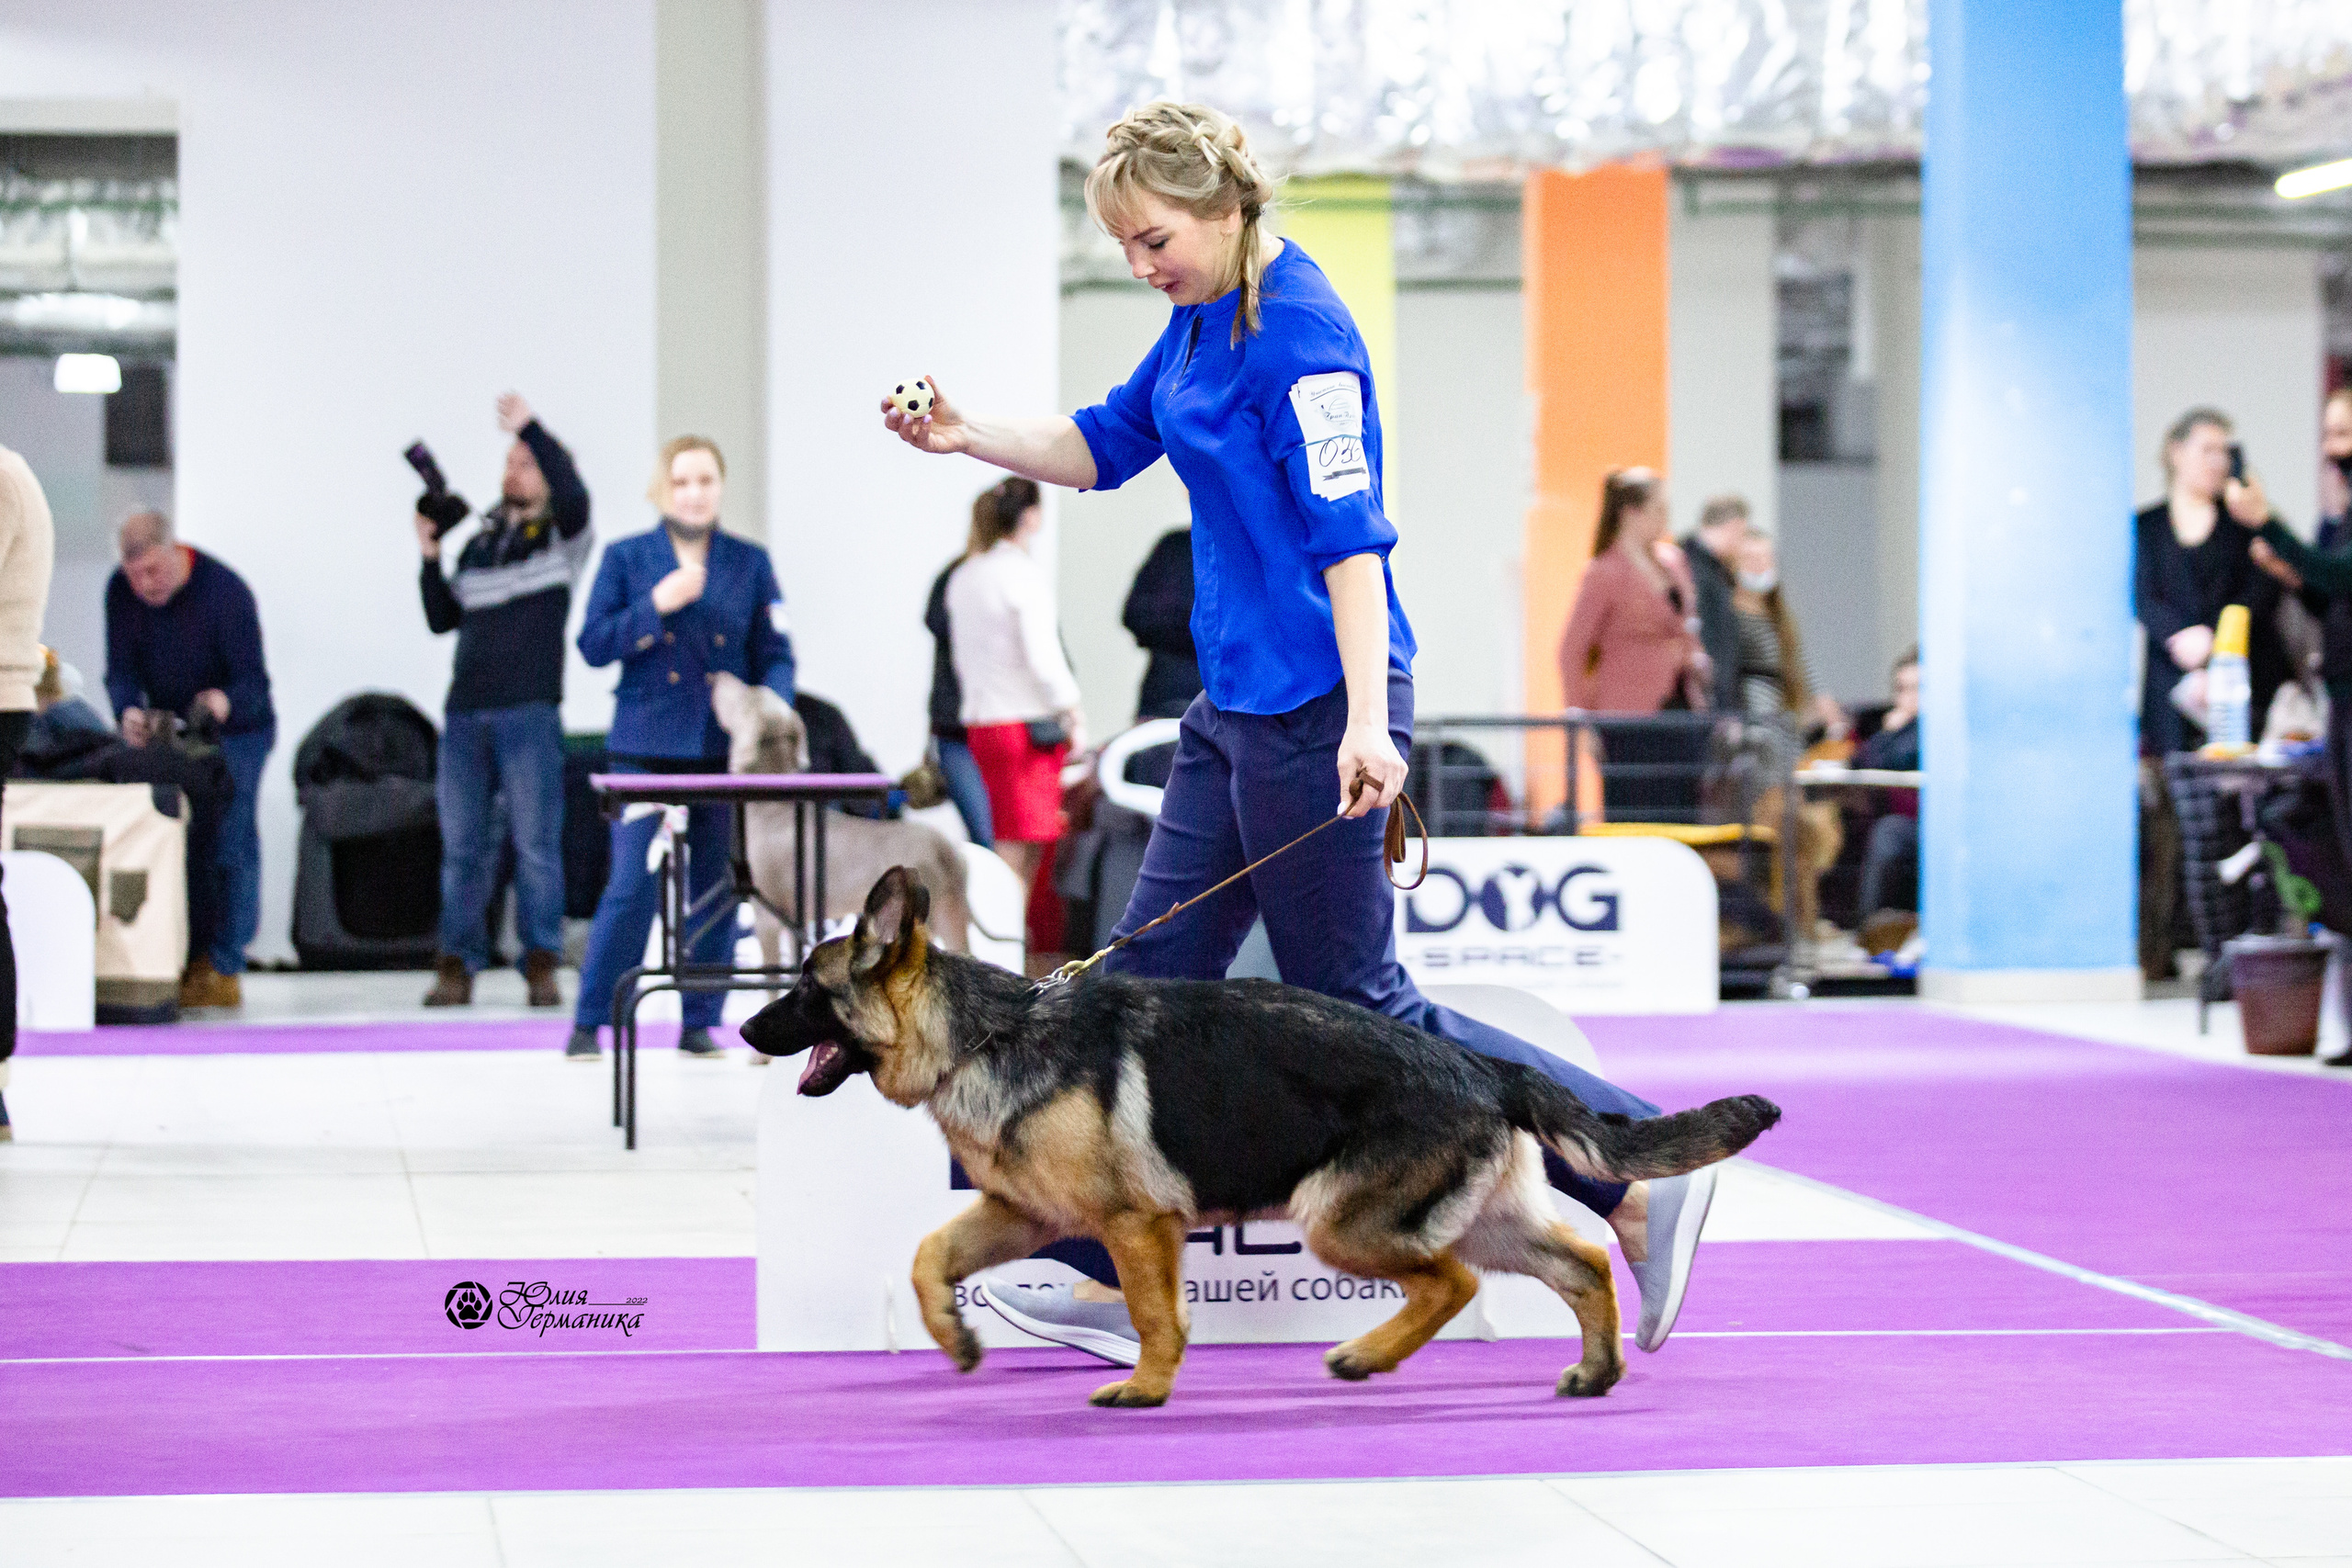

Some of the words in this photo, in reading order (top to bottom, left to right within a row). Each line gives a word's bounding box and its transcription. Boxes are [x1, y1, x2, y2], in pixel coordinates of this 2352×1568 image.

[1406, 864, 1619, 933] DOG
[1185, 1271, 1280, 1303] ашей
[1291, 1273, 1407, 1301] собак
